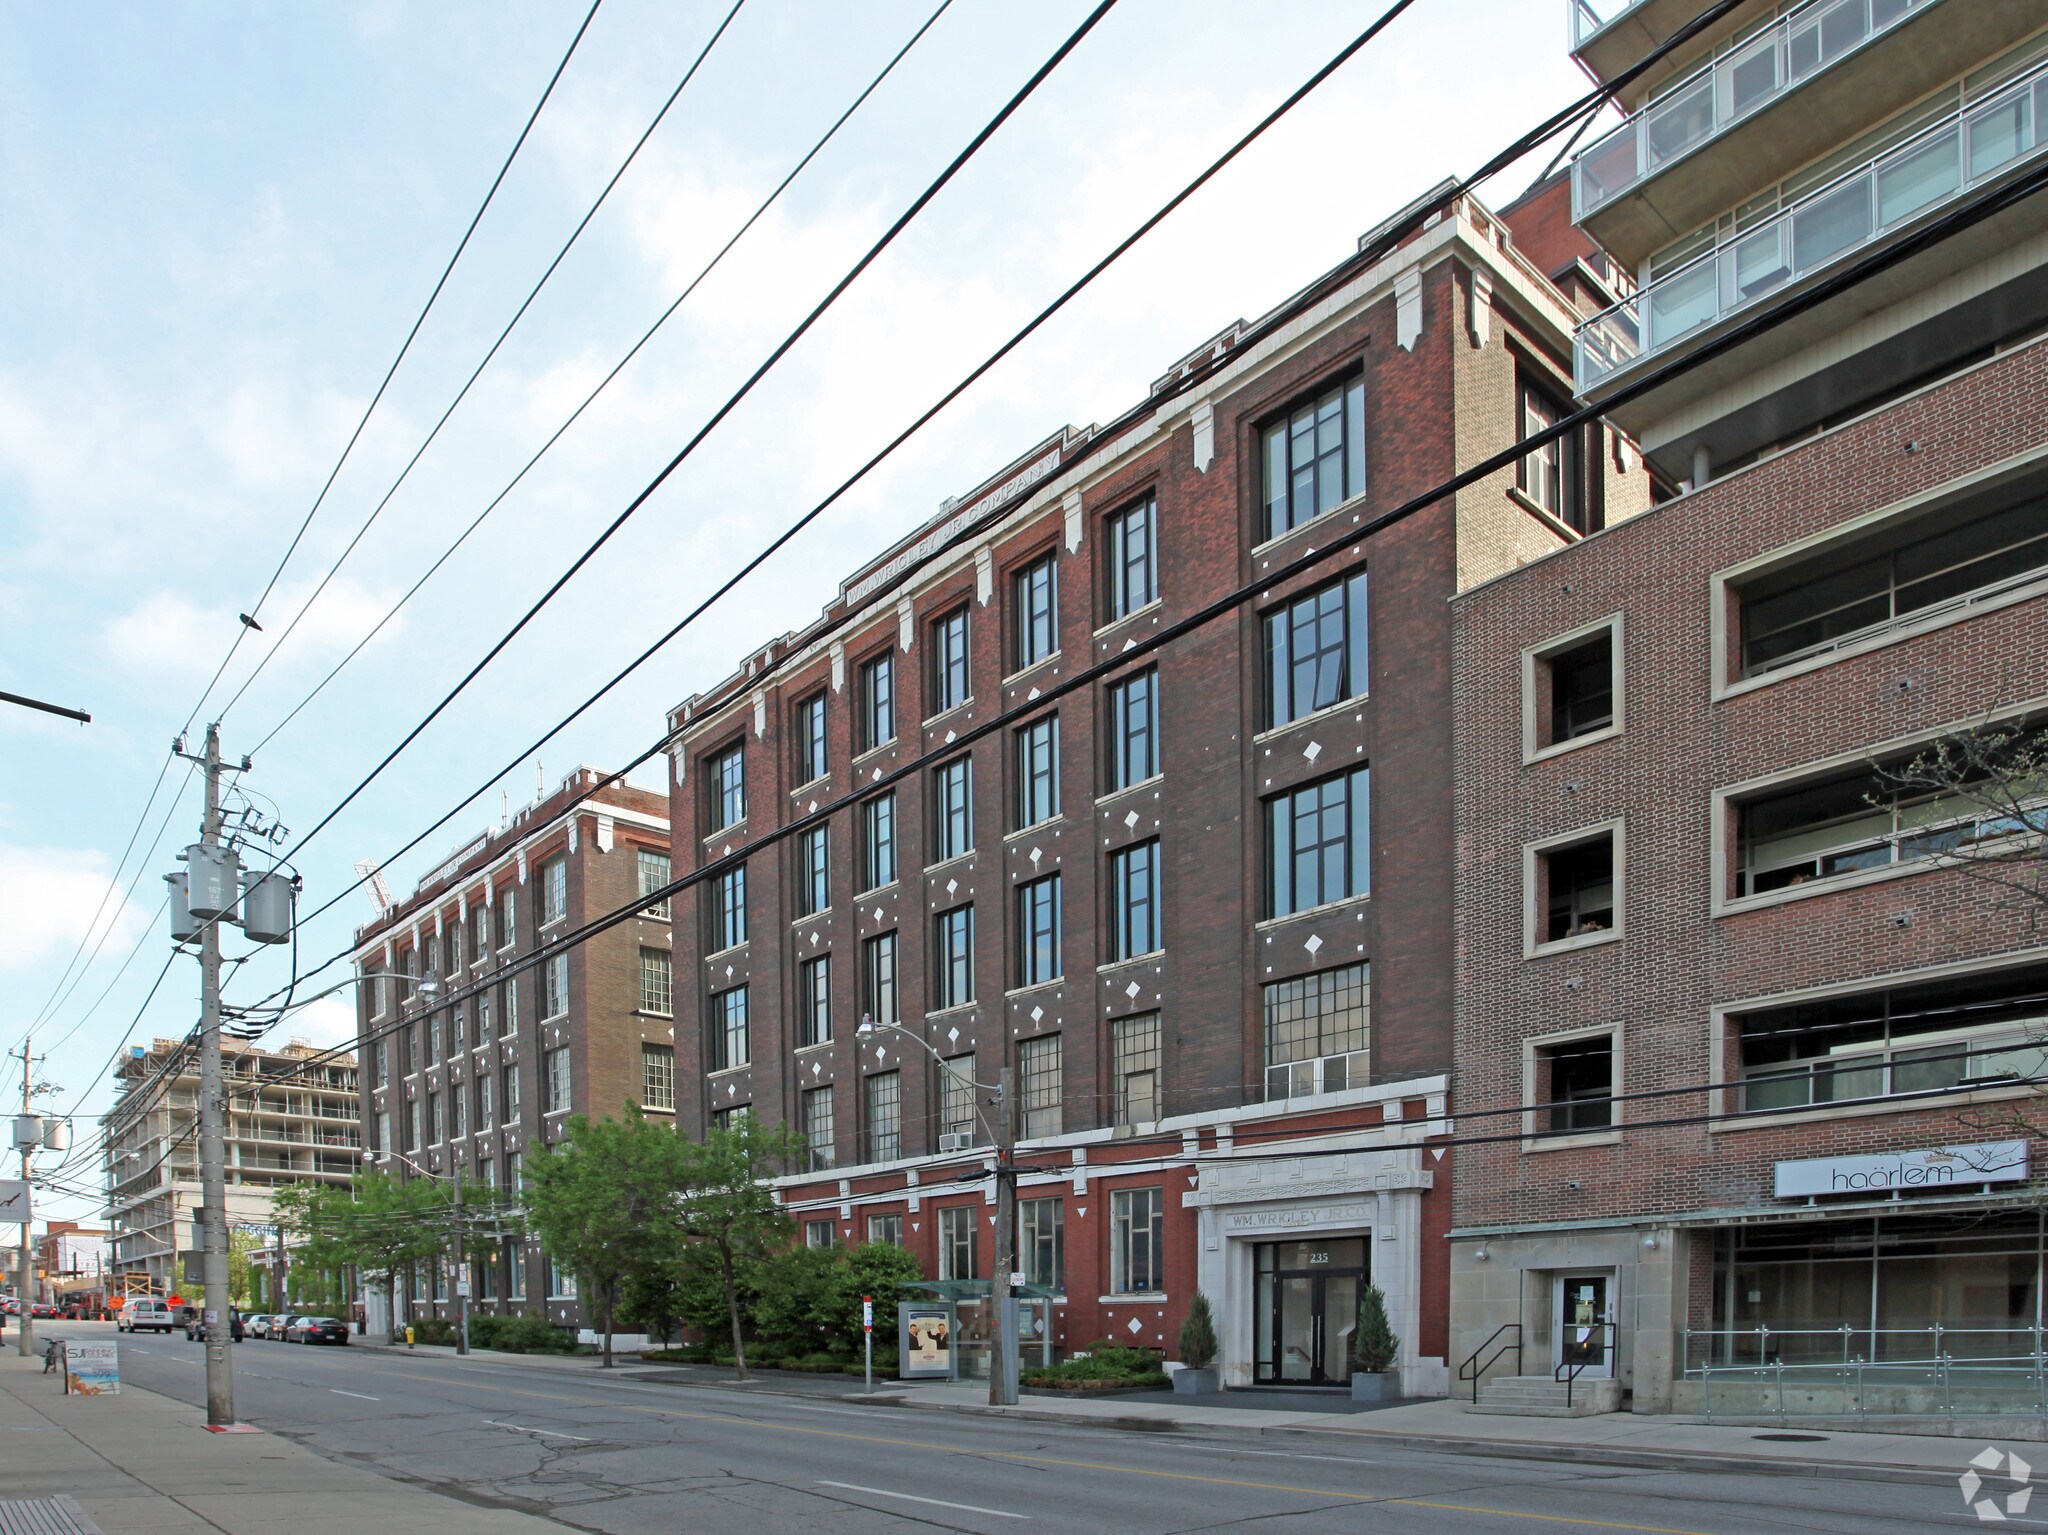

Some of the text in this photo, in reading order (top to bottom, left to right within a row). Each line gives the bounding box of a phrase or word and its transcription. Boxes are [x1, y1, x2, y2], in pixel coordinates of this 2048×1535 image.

[874, 533, 937, 586] WRIGLEY
[968, 450, 1058, 523] COMPANY
[1257, 1209, 1320, 1225] WRIGLEY
[1310, 1252, 1328, 1263] 235
